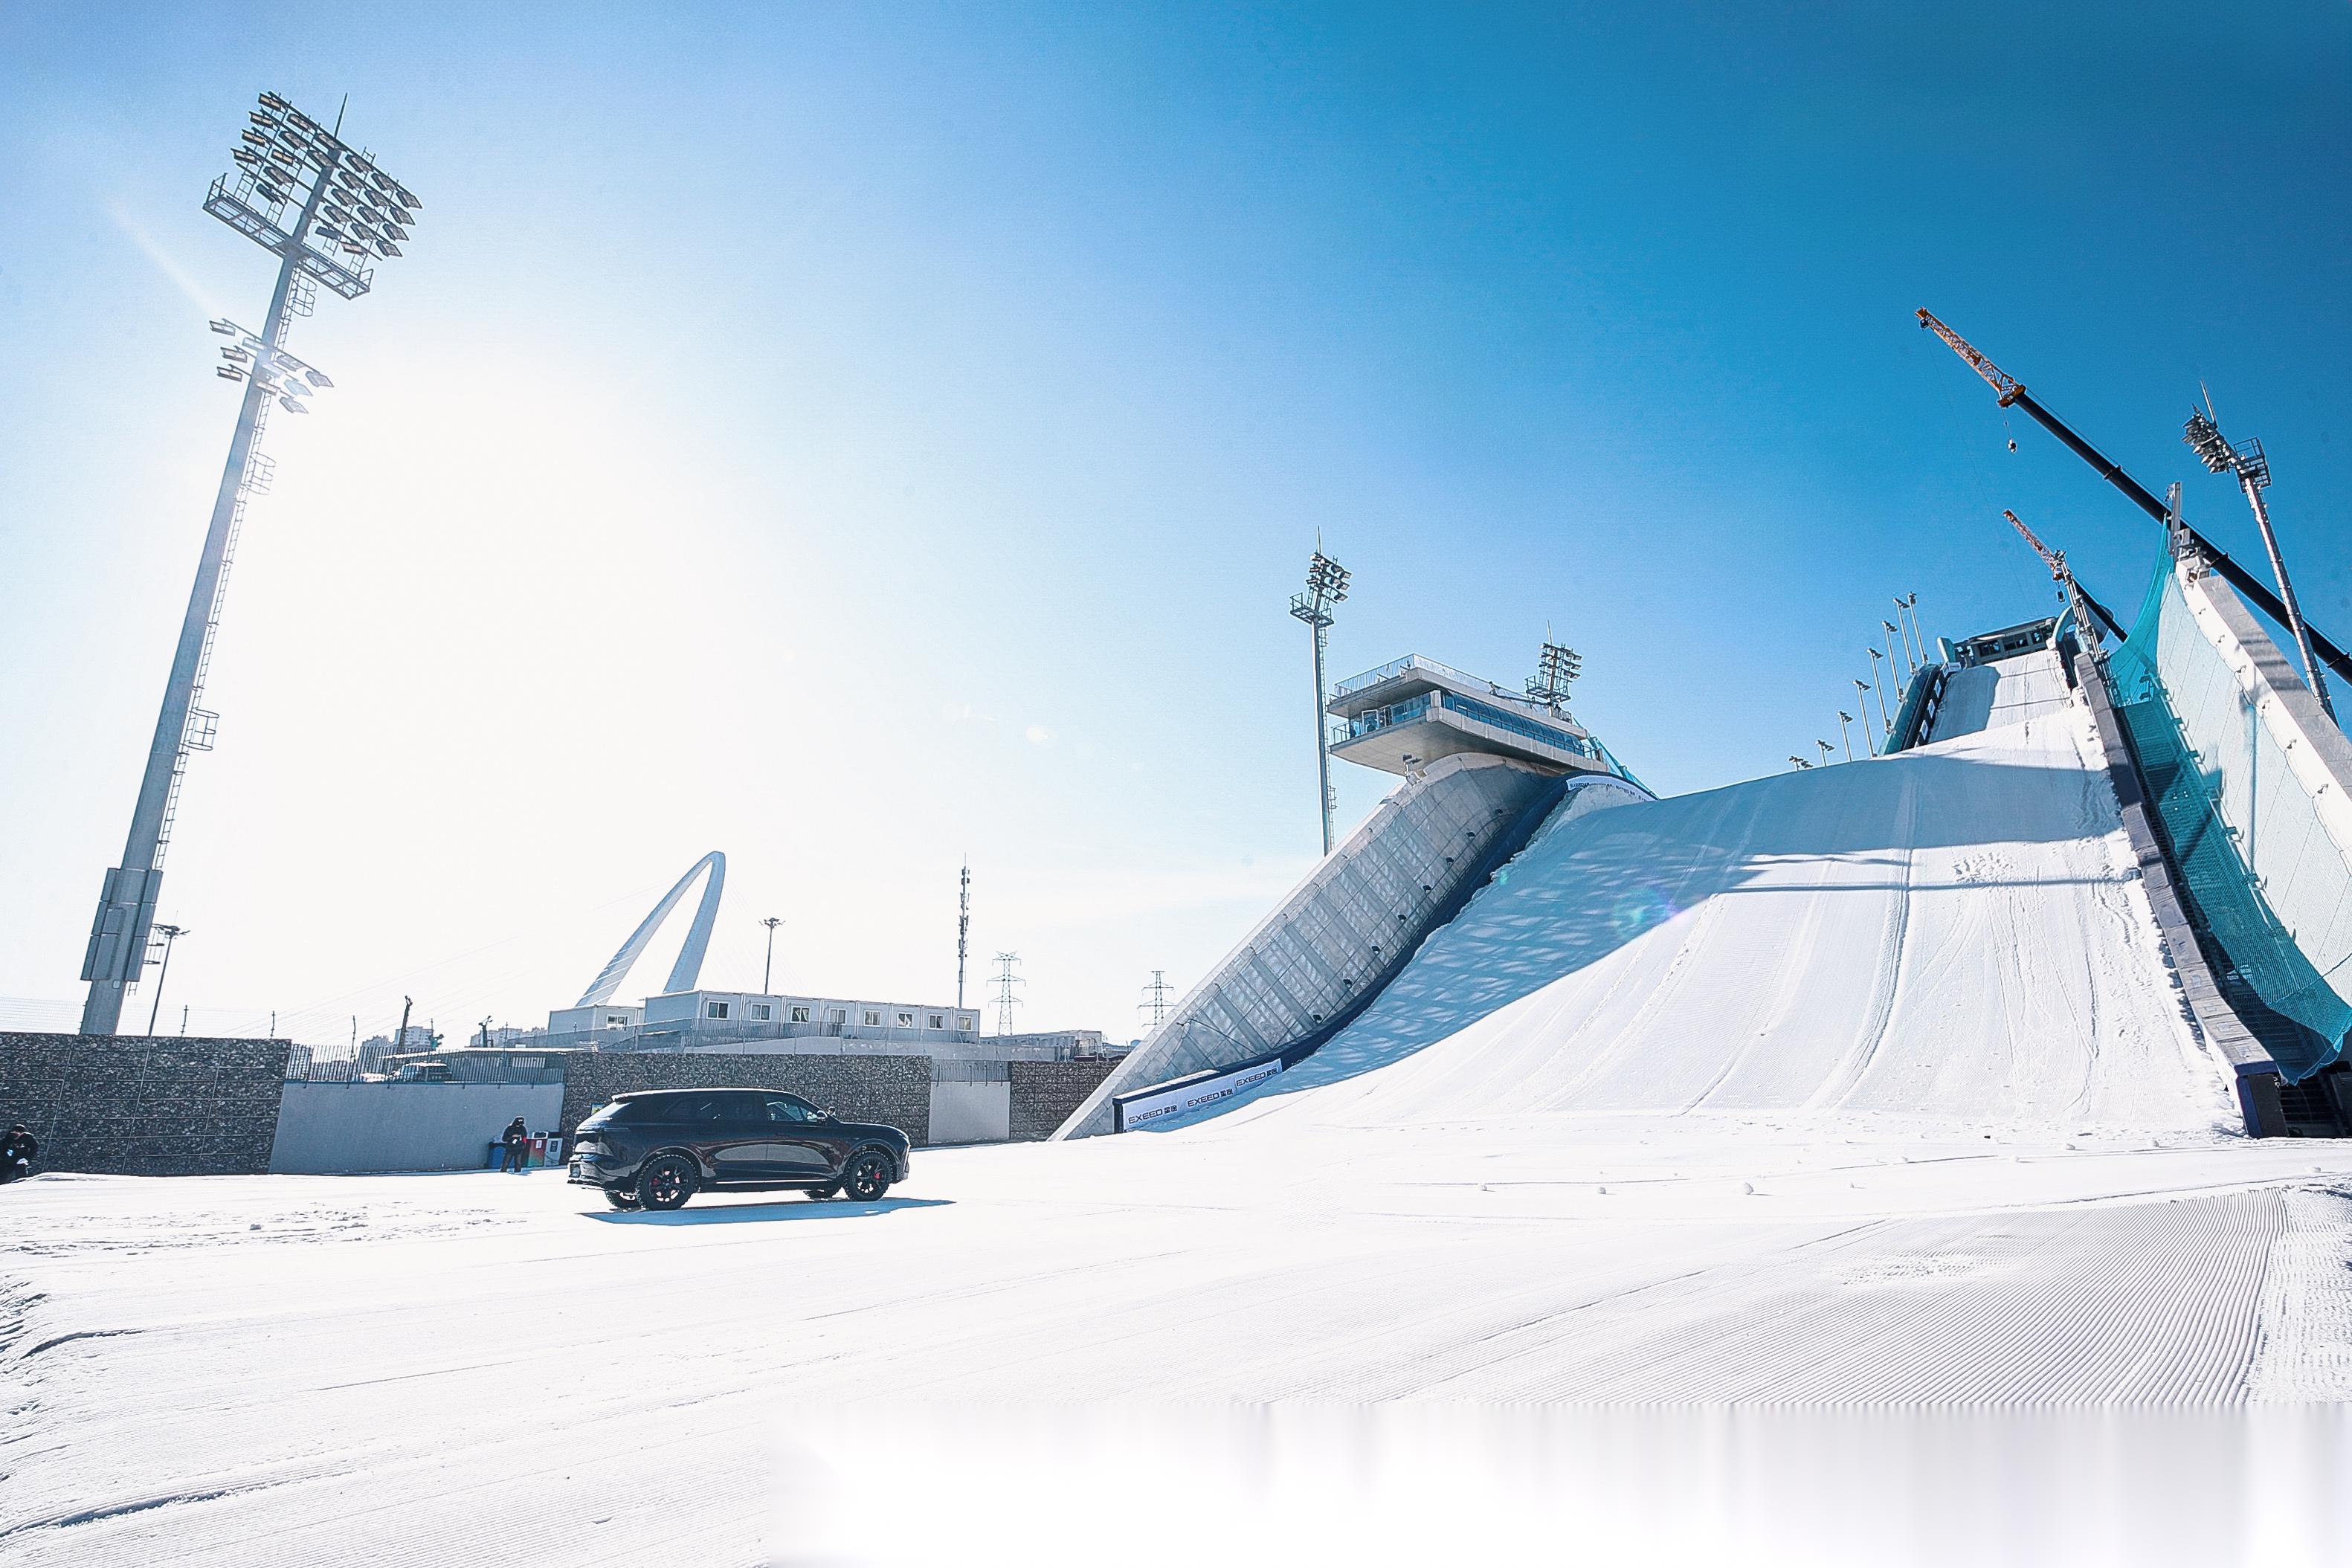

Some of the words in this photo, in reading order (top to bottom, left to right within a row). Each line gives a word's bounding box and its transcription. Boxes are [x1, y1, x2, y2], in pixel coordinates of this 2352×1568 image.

[1236, 1072, 1266, 1086] EXEED
[1188, 1092, 1220, 1107] EXEED
[1128, 1109, 1163, 1124] EXEED
